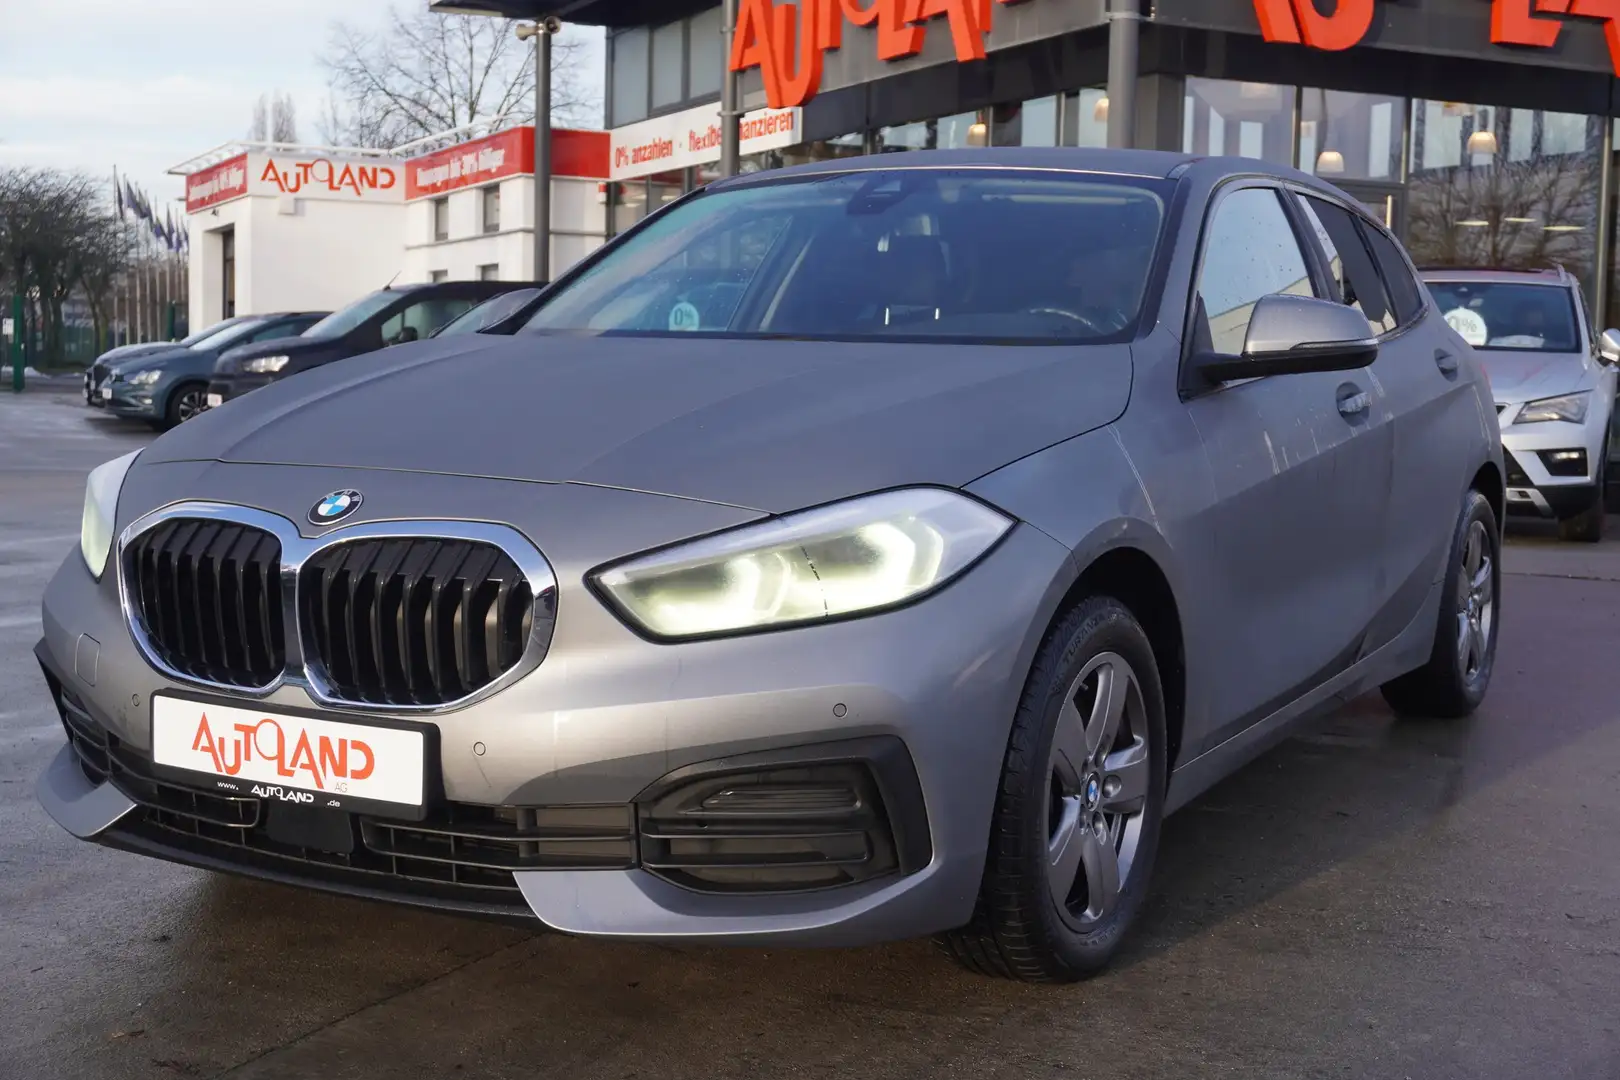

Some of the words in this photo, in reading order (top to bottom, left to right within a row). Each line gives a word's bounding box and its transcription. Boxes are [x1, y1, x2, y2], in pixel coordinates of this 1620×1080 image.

[615, 144, 630, 169] 0%
[632, 138, 673, 164] anzahlen
[688, 124, 722, 152] flexibe
[261, 159, 396, 196] AUTOLAND
[192, 712, 375, 789] AUTOLAND
[217, 781, 239, 791] www.
[251, 784, 314, 803] AUTOLAND
[326, 799, 341, 808] .de
[334, 782, 348, 792] AG
